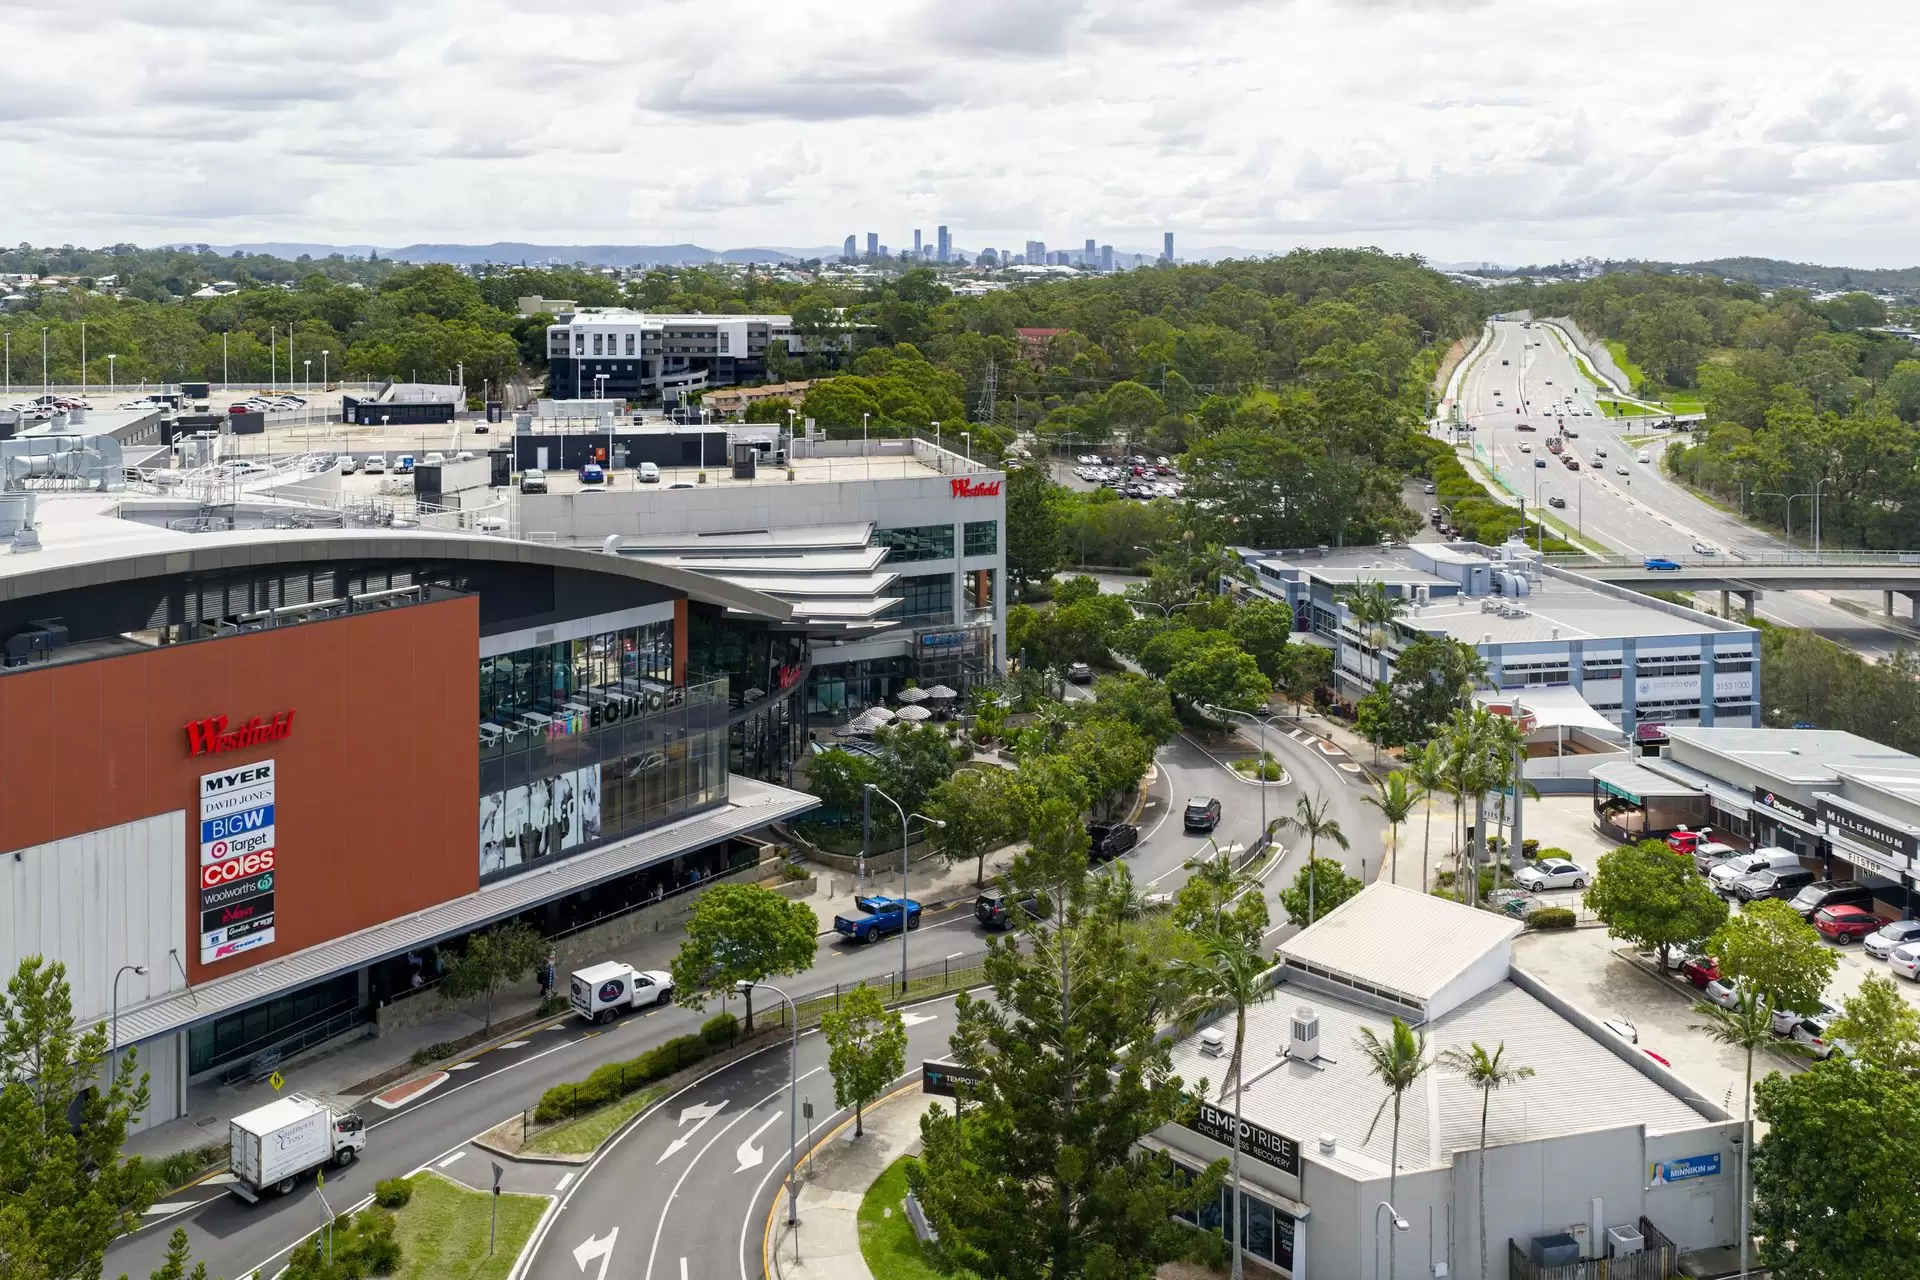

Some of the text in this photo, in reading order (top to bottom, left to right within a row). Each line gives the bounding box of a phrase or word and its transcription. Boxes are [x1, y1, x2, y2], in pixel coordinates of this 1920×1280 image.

[950, 478, 1001, 499] Westfield
[1715, 681, 1733, 691] 3153
[1734, 680, 1750, 690] 1000
[182, 708, 296, 759] Westfield
[205, 766, 271, 792] MYER
[205, 789, 272, 814] DAVID JONES
[1826, 809, 1903, 849] MILLENNIUM
[229, 832, 267, 852] Target
[204, 850, 274, 885] coles
[1848, 853, 1882, 872] FITSTOP
[215, 937, 263, 958] Kmart
[1197, 1122, 1220, 1138] CYCLE
[1253, 1147, 1291, 1169] RECOVERY
[1670, 1165, 1706, 1178] MINNIKIN
